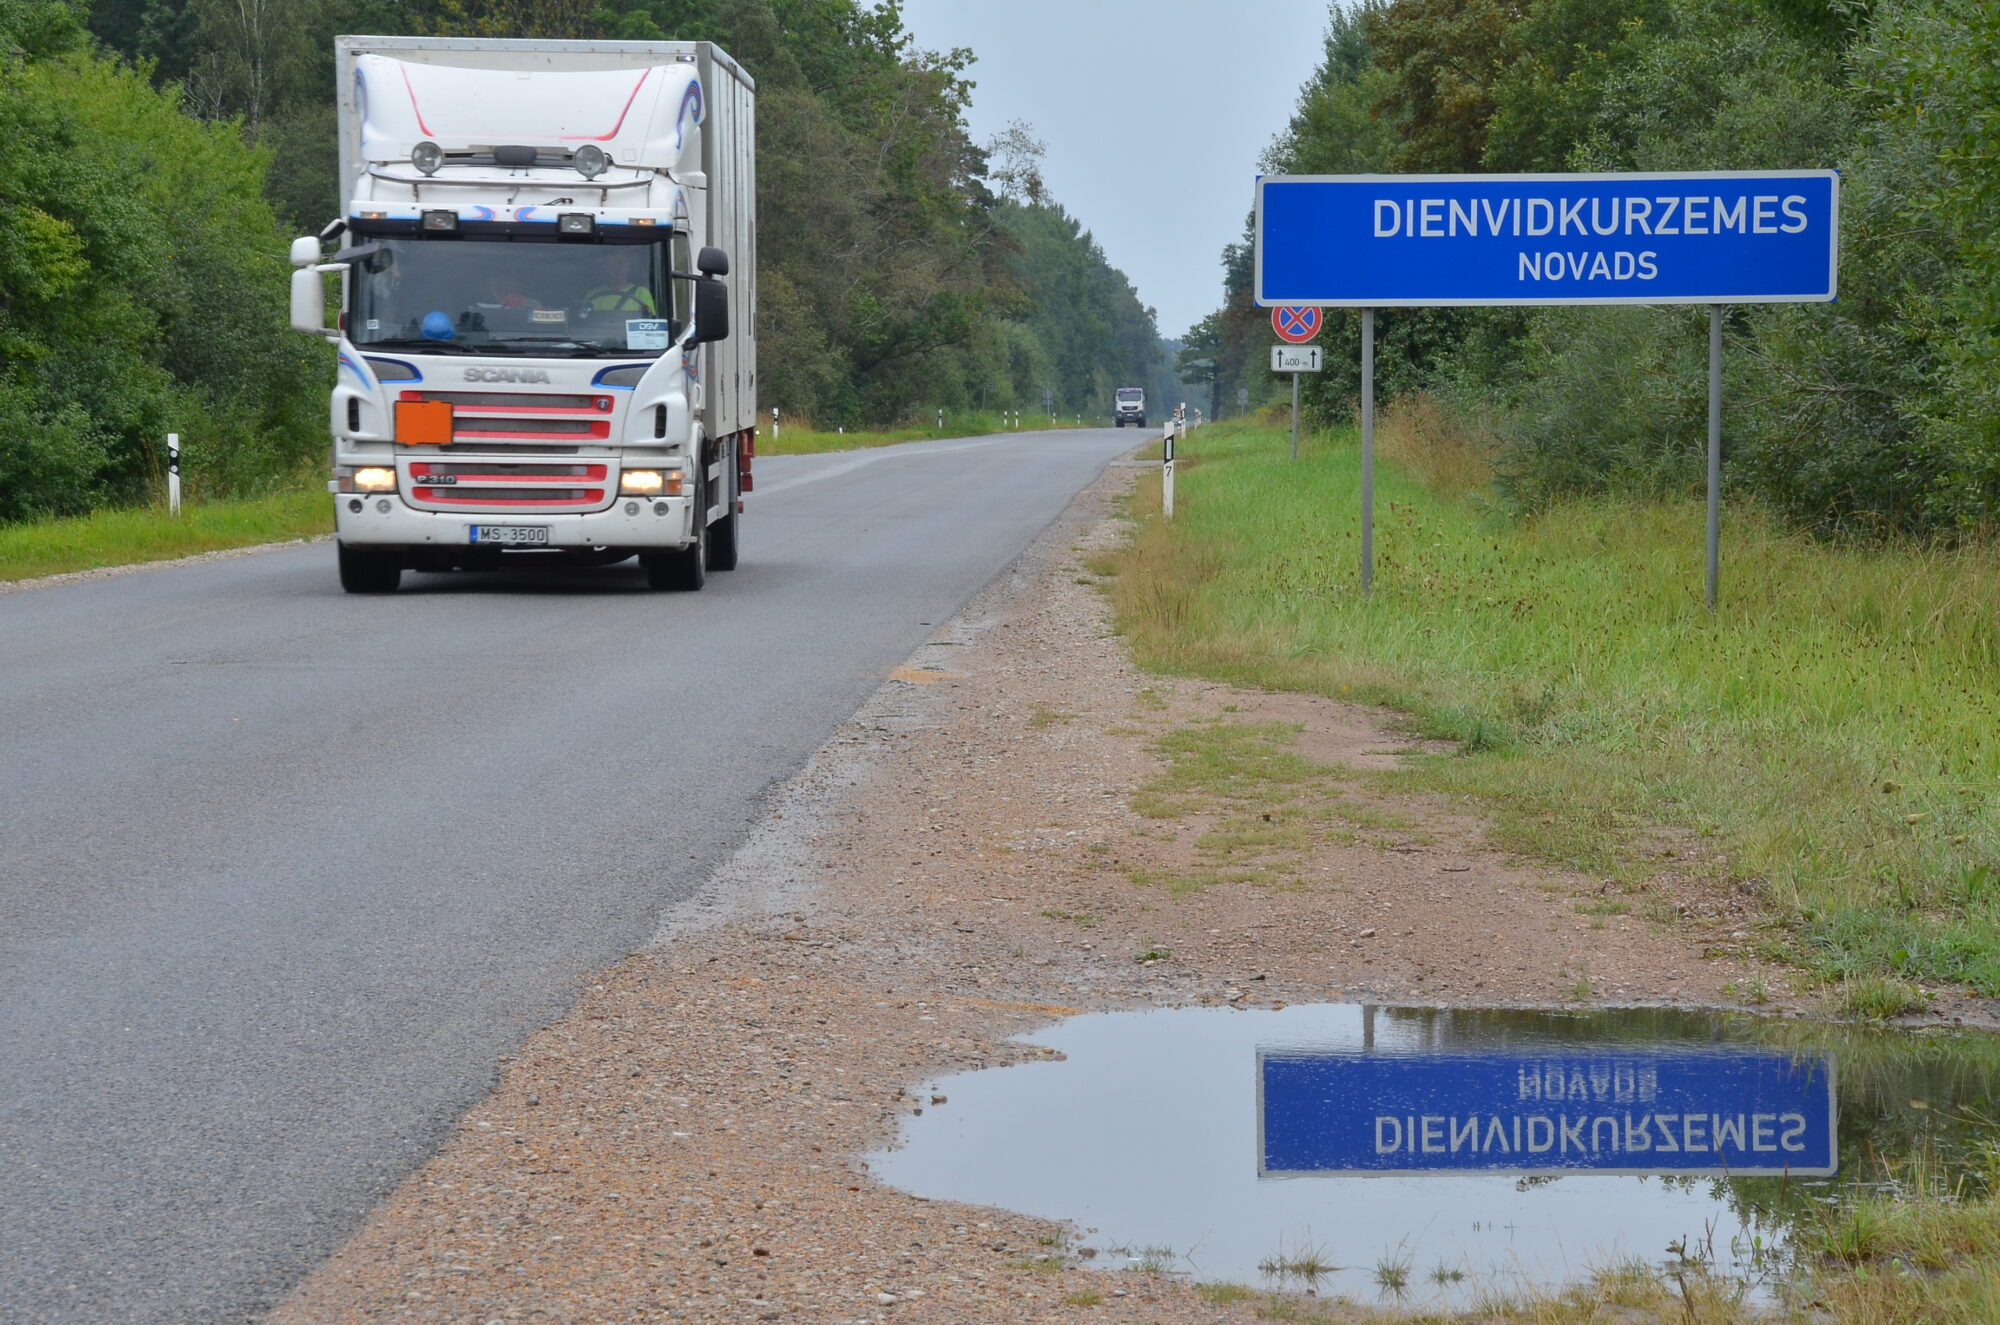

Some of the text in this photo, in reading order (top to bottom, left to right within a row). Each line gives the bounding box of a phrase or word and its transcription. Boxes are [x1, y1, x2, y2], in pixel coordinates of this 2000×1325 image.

[1374, 195, 1808, 238] DIENVIDKURZEMES
[1518, 250, 1658, 281] NOVADS
[1284, 358, 1300, 366] 400
[463, 367, 551, 384] SCANIA
[1165, 466, 1172, 477] 7
[417, 475, 455, 484] P 310
